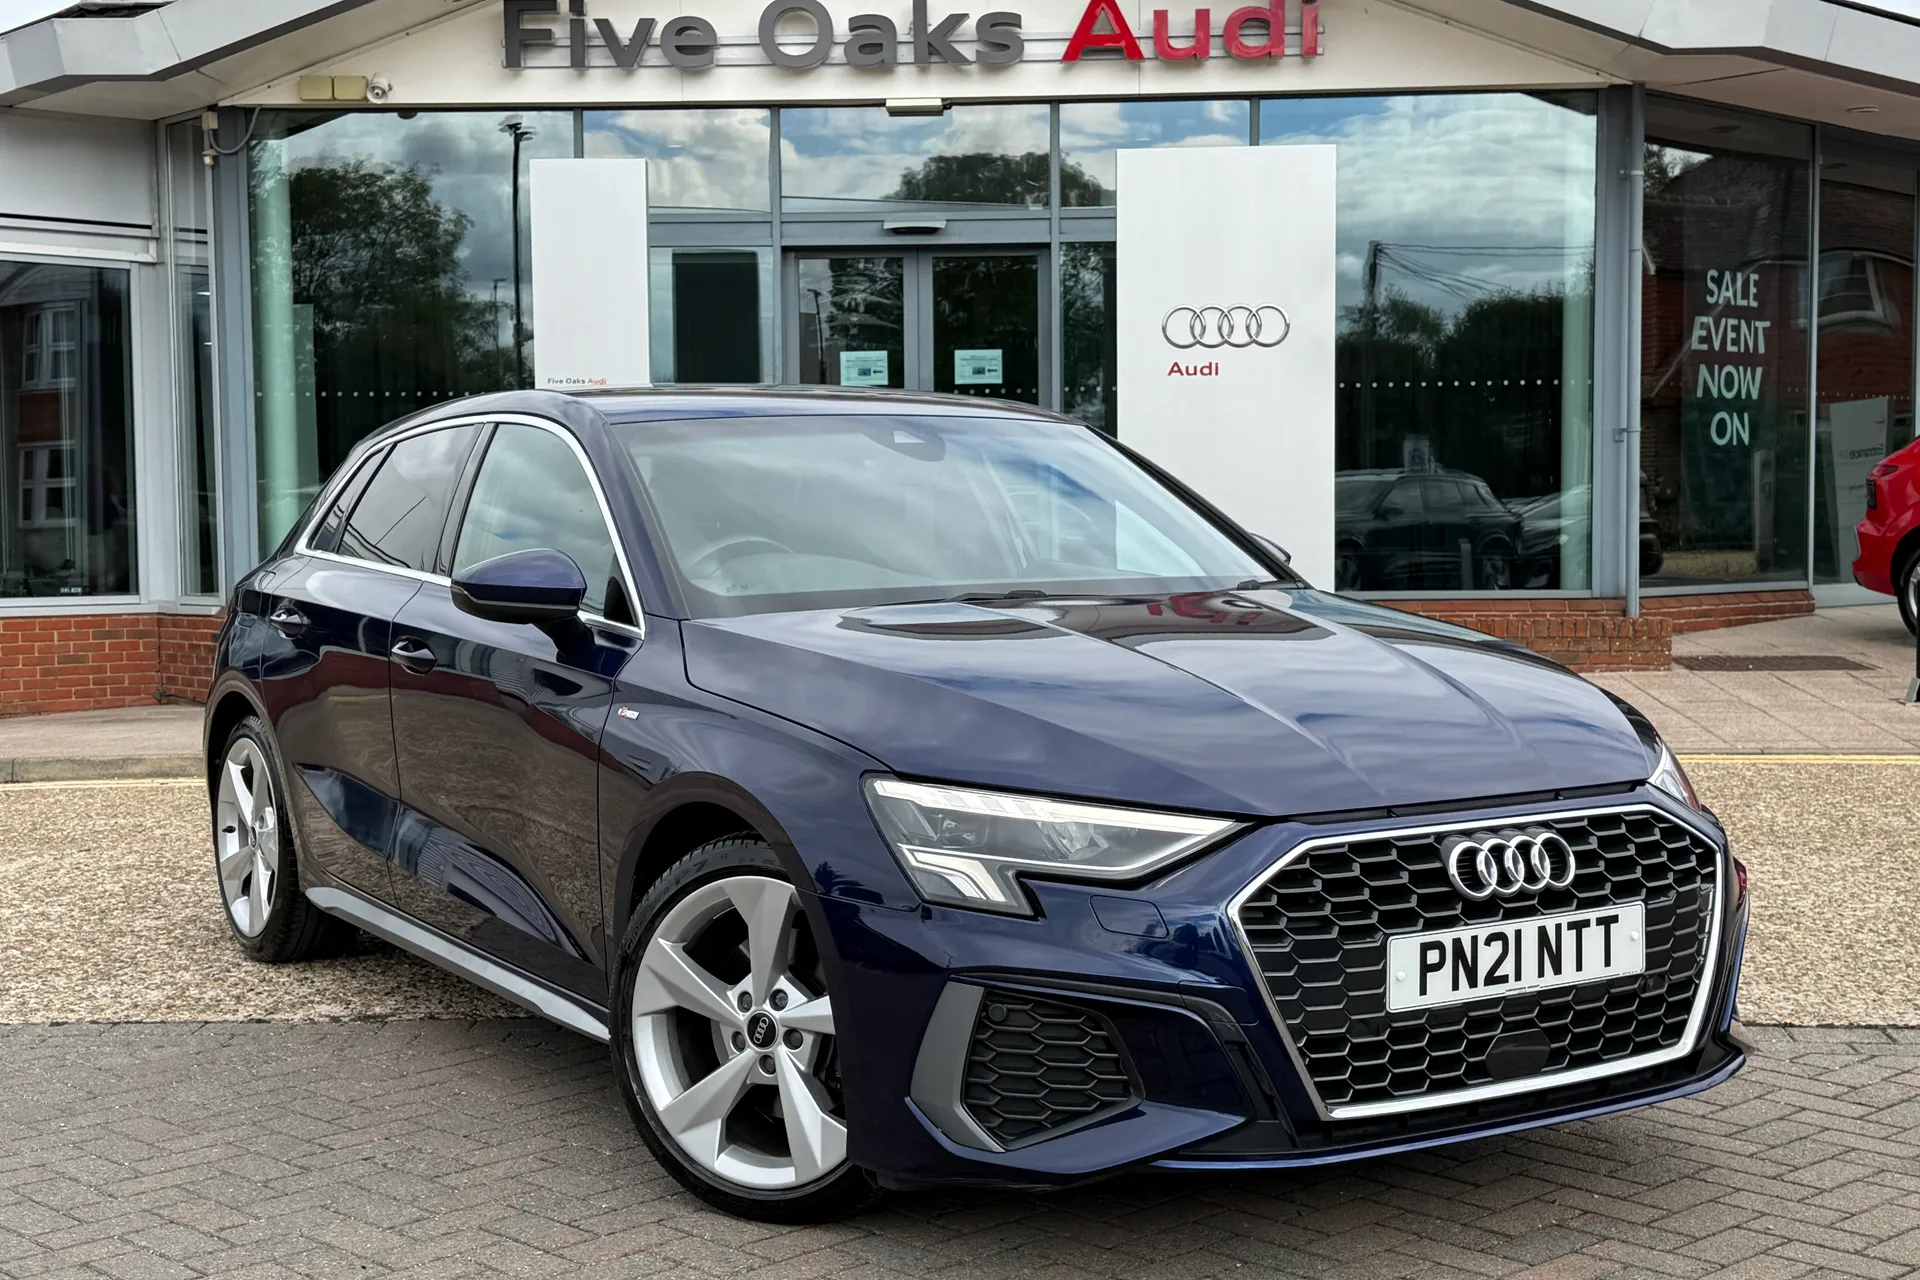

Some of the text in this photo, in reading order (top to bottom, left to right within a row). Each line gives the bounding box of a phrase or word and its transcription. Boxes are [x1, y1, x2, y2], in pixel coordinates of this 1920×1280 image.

[503, 0, 1319, 69] Five Oaks Audi
[1706, 269, 1759, 308] SALE
[1690, 316, 1771, 354] EVENT
[547, 377, 607, 386] Five Oaks Audi
[1167, 361, 1219, 377] Audi
[1696, 364, 1763, 400] NOW
[1710, 411, 1749, 446] ON
[1418, 914, 1620, 997] PN21 NTT
